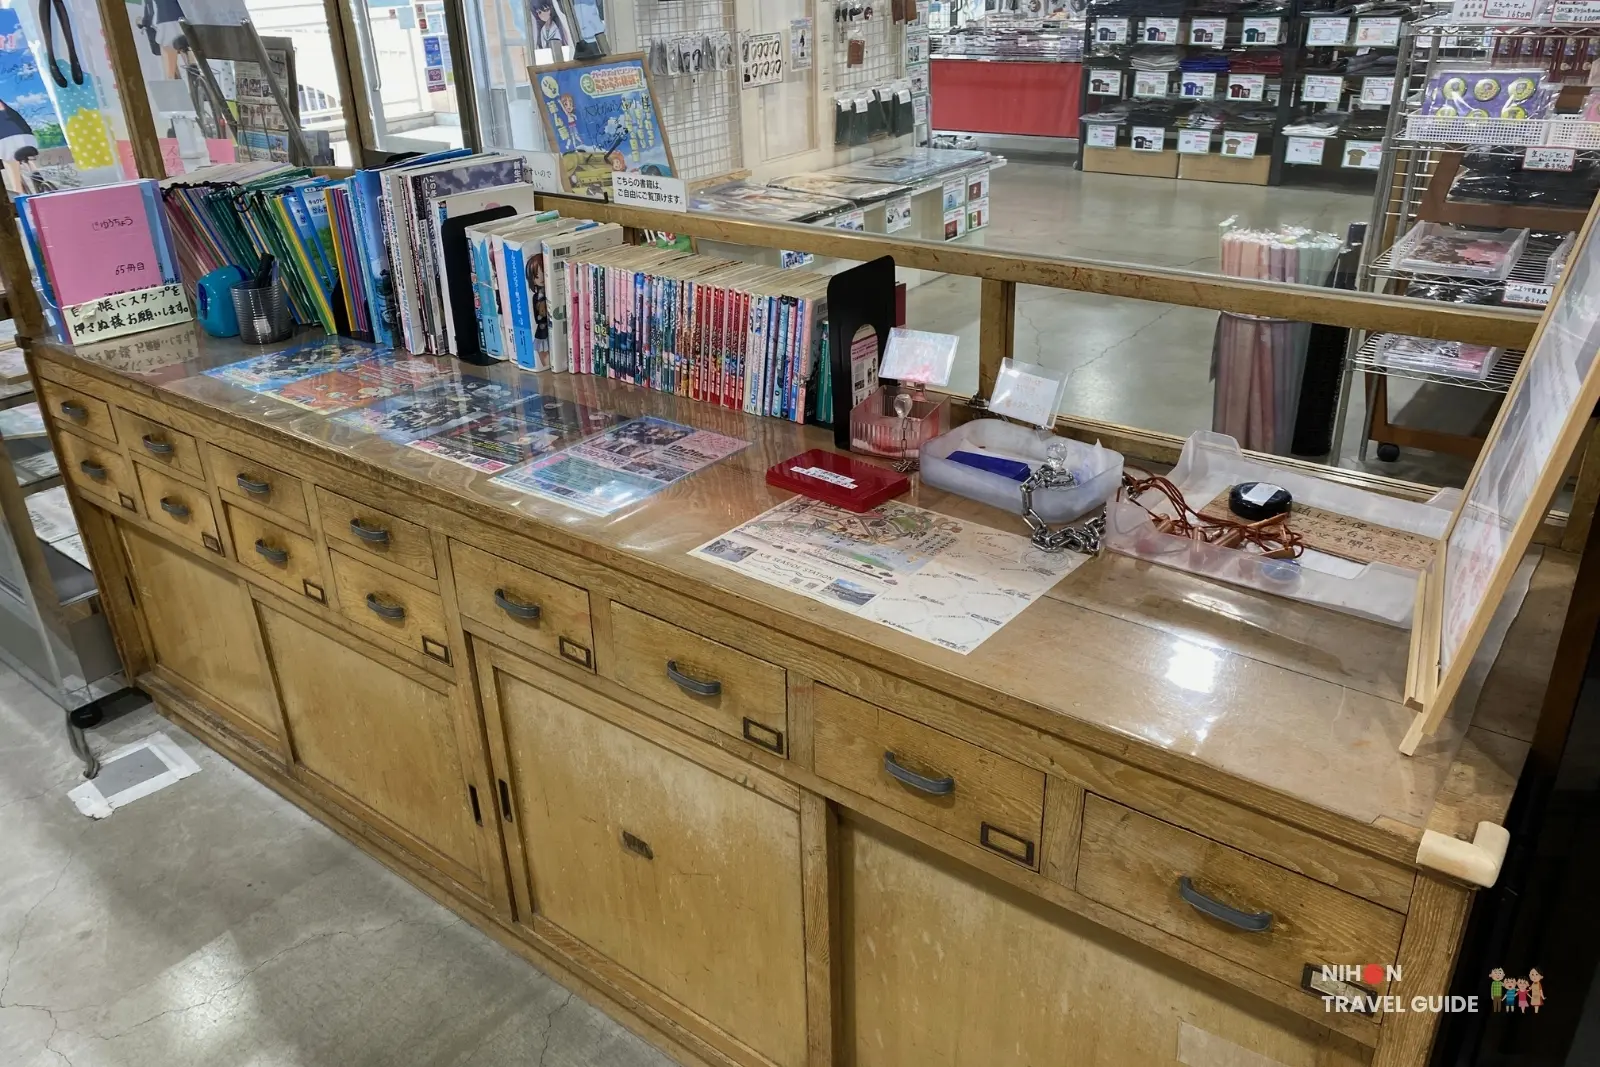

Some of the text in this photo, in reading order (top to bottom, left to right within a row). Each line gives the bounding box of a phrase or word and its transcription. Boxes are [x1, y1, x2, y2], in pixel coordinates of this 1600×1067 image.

[616, 176, 663, 190] こちらの書籍は、
[617, 188, 682, 204] ご自由にご覧頂けます。
[115, 262, 145, 275] 65冊目
[71, 285, 181, 317] 自帳にスタンプを
[73, 302, 189, 337] 押さぬ様お願いします。
[803, 568, 835, 581] STATION
